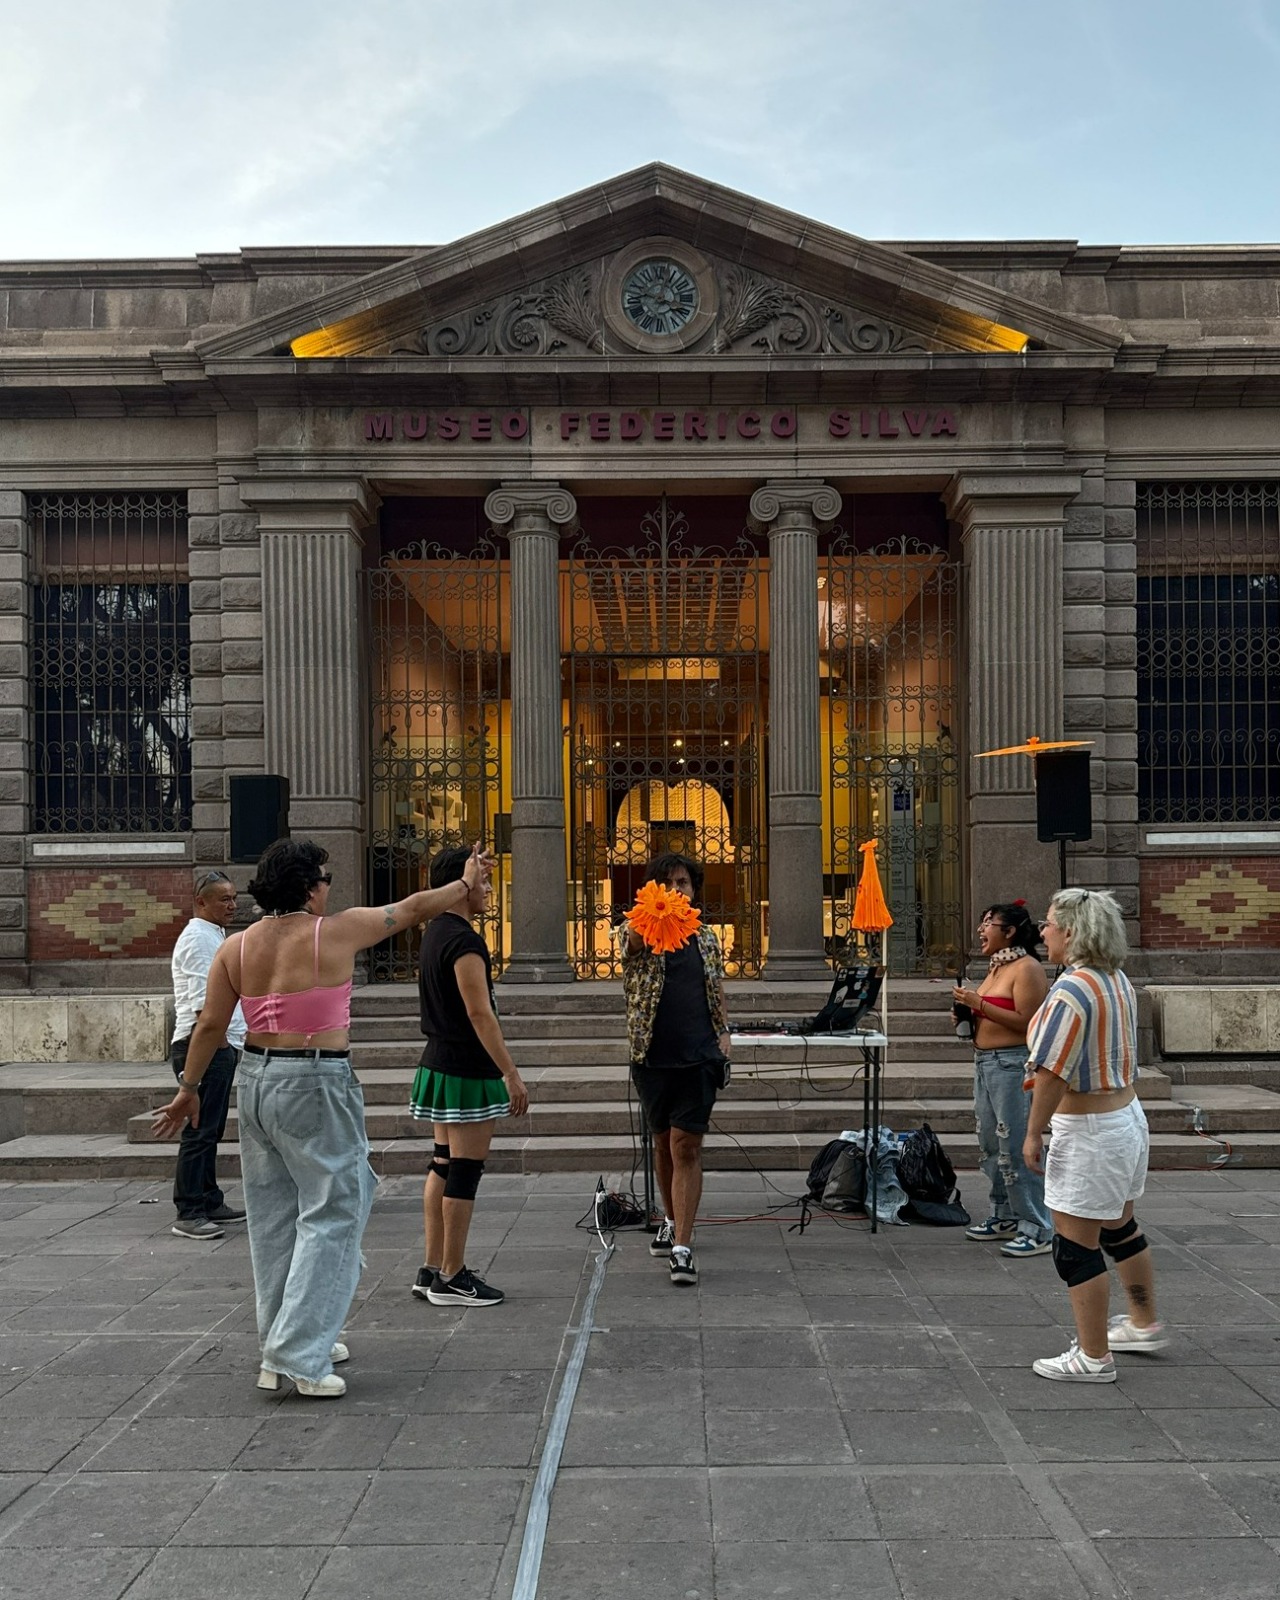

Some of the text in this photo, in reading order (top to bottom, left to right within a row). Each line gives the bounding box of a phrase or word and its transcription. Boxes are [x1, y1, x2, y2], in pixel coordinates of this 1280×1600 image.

[364, 409, 958, 441] MUSEO FEDERICO SILVA
